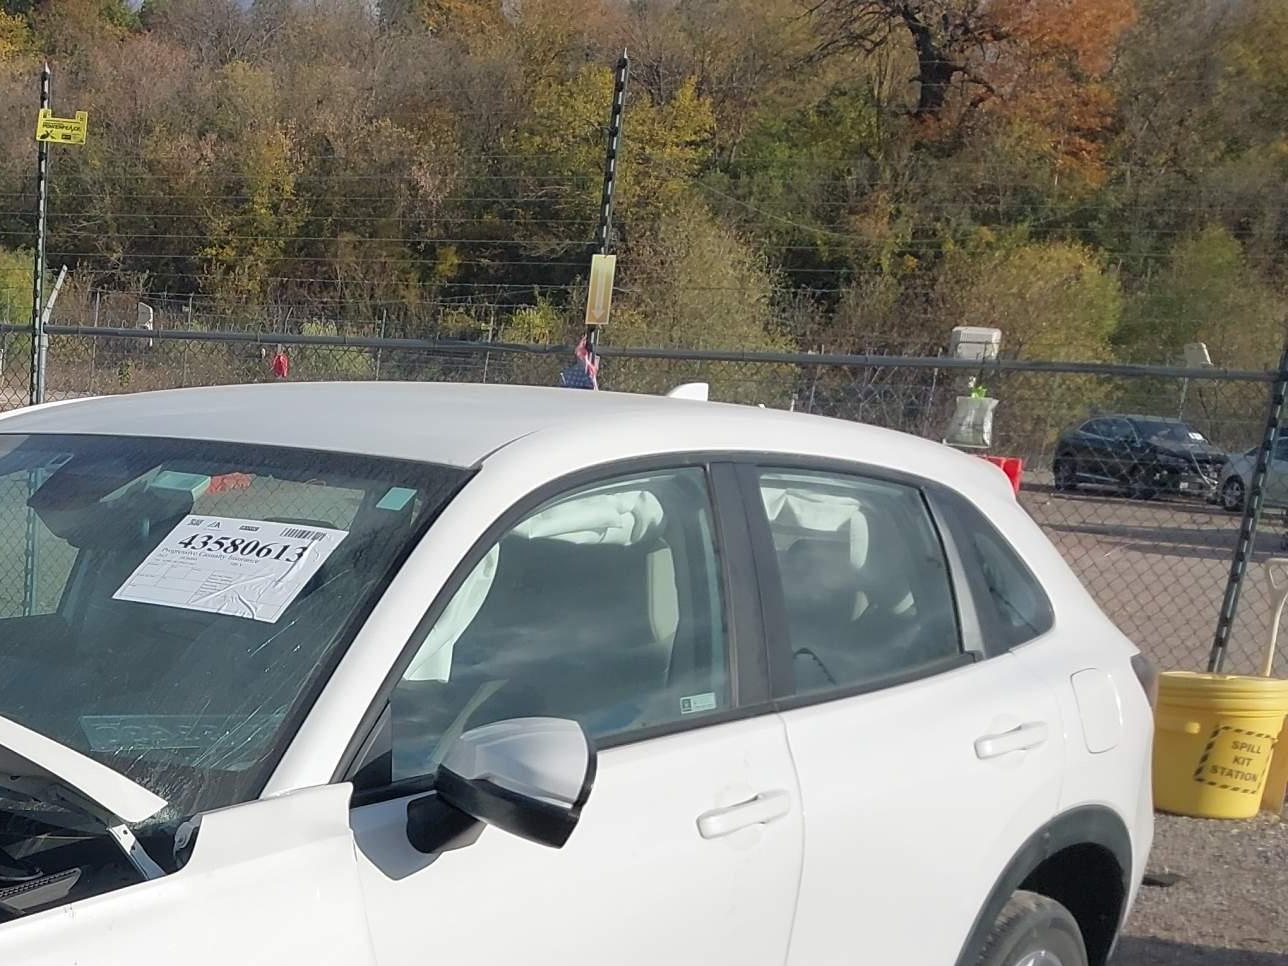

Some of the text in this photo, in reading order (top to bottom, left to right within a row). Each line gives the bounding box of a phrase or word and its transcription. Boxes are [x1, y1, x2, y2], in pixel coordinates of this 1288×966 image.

[178, 533, 308, 563] 43580613
[1231, 741, 1262, 754] SPILL
[1232, 756, 1253, 768] KIT
[1210, 765, 1258, 782] STATION
